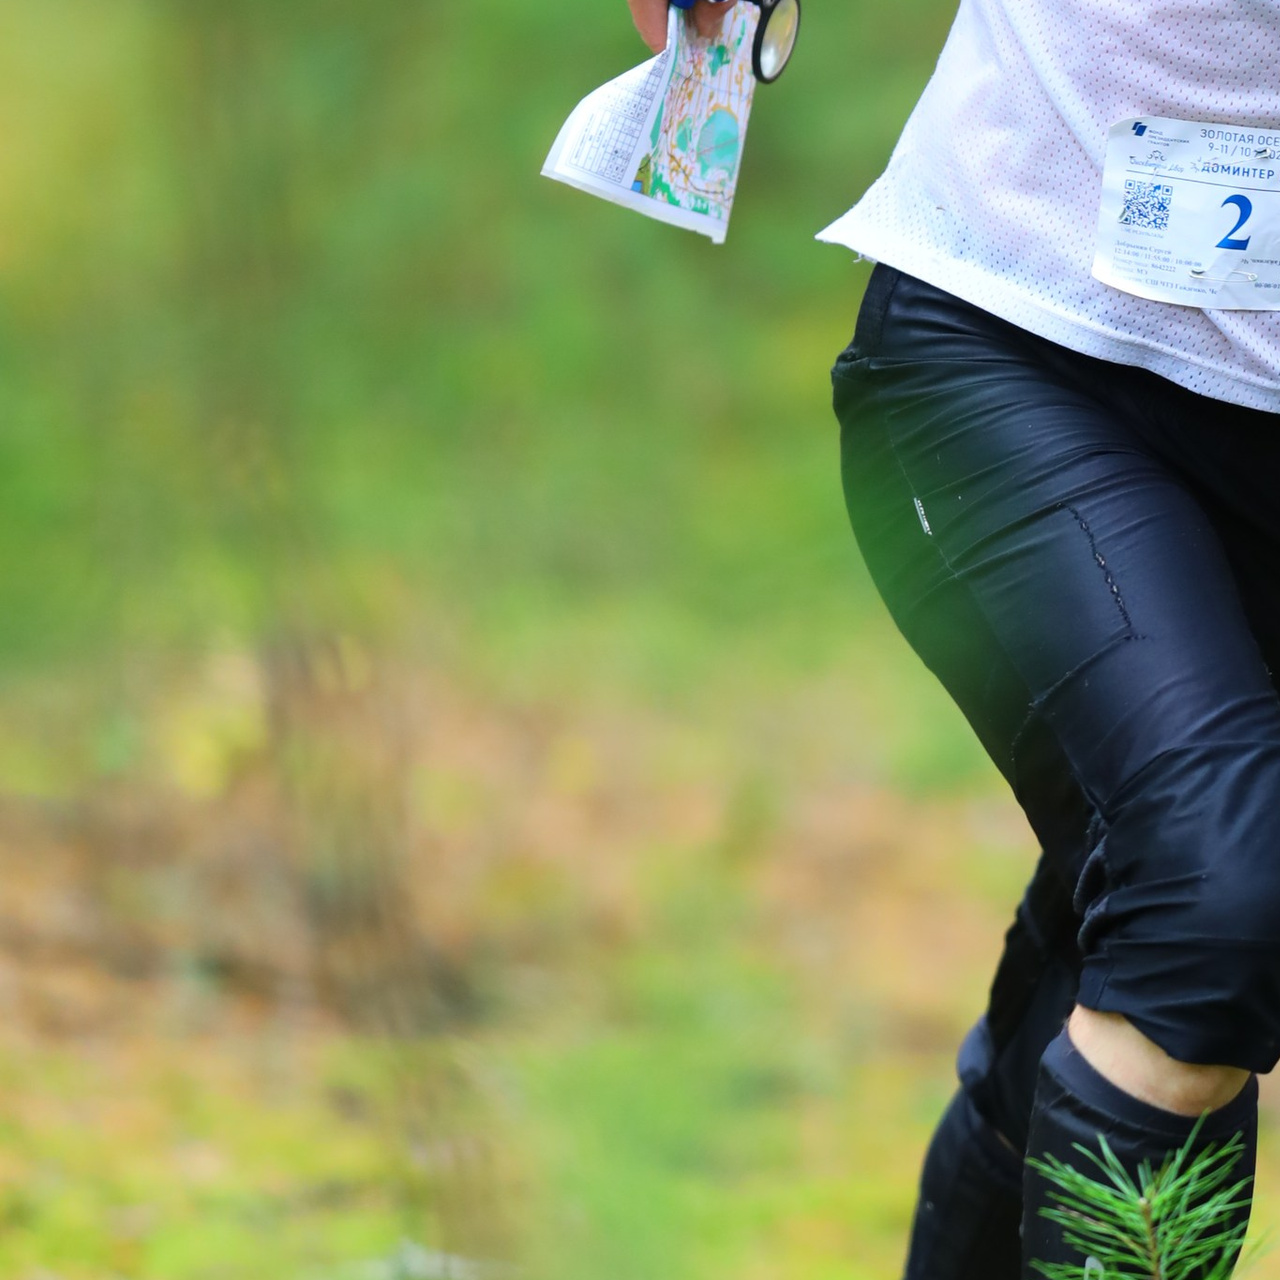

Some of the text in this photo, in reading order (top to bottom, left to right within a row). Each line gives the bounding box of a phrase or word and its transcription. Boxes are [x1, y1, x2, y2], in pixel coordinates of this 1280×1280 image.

[1200, 128, 1254, 144] ЗОЛОТАЯ
[1208, 142, 1228, 154] 9-11
[1240, 147, 1251, 157] 10
[1201, 162, 1275, 179] ДОМИНТЕР
[1215, 194, 1253, 251] 2
